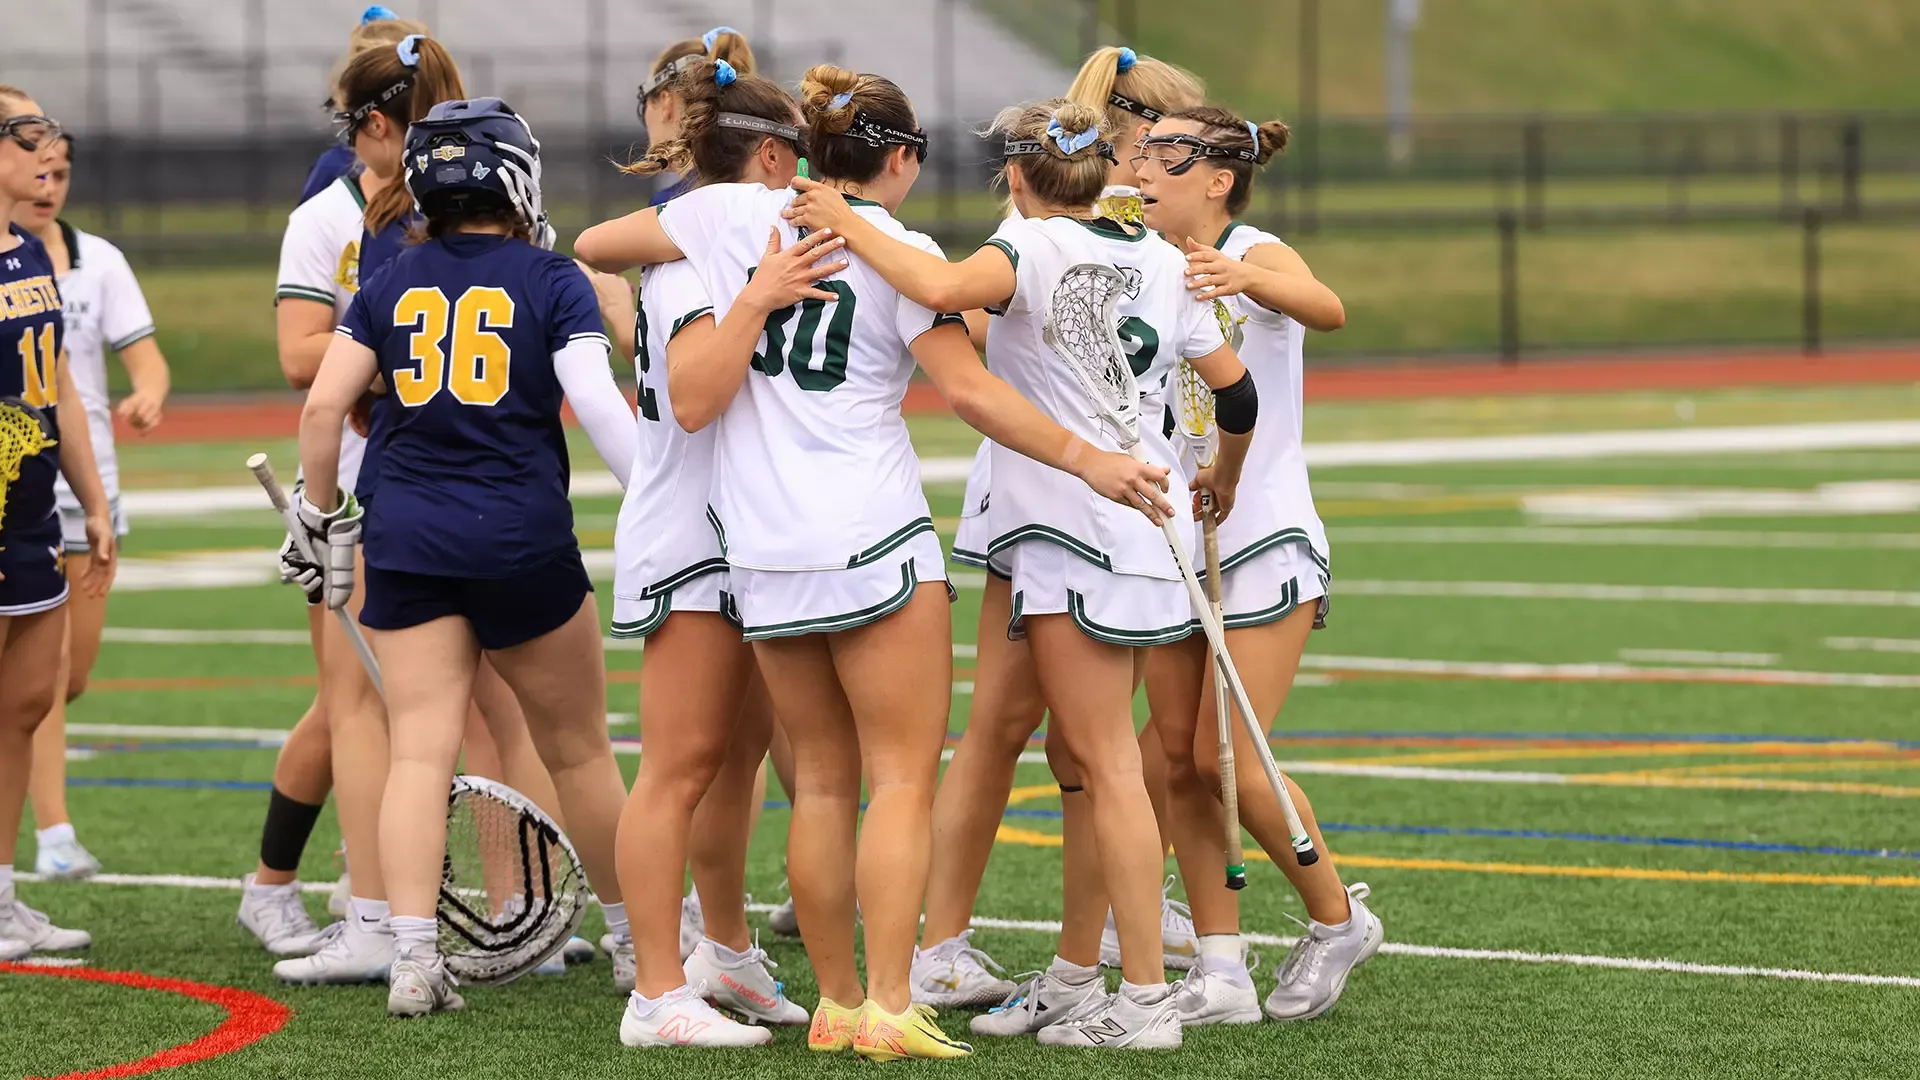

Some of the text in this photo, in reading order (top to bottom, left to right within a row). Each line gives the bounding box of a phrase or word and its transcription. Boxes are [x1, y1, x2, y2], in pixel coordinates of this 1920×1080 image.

[354, 80, 408, 120] STX STX
[732, 119, 799, 138] UNDER ARM
[1141, 108, 1165, 122] ST
[883, 128, 925, 144] ARMOUR
[393, 285, 516, 408] 36
[17, 321, 58, 410] 11
